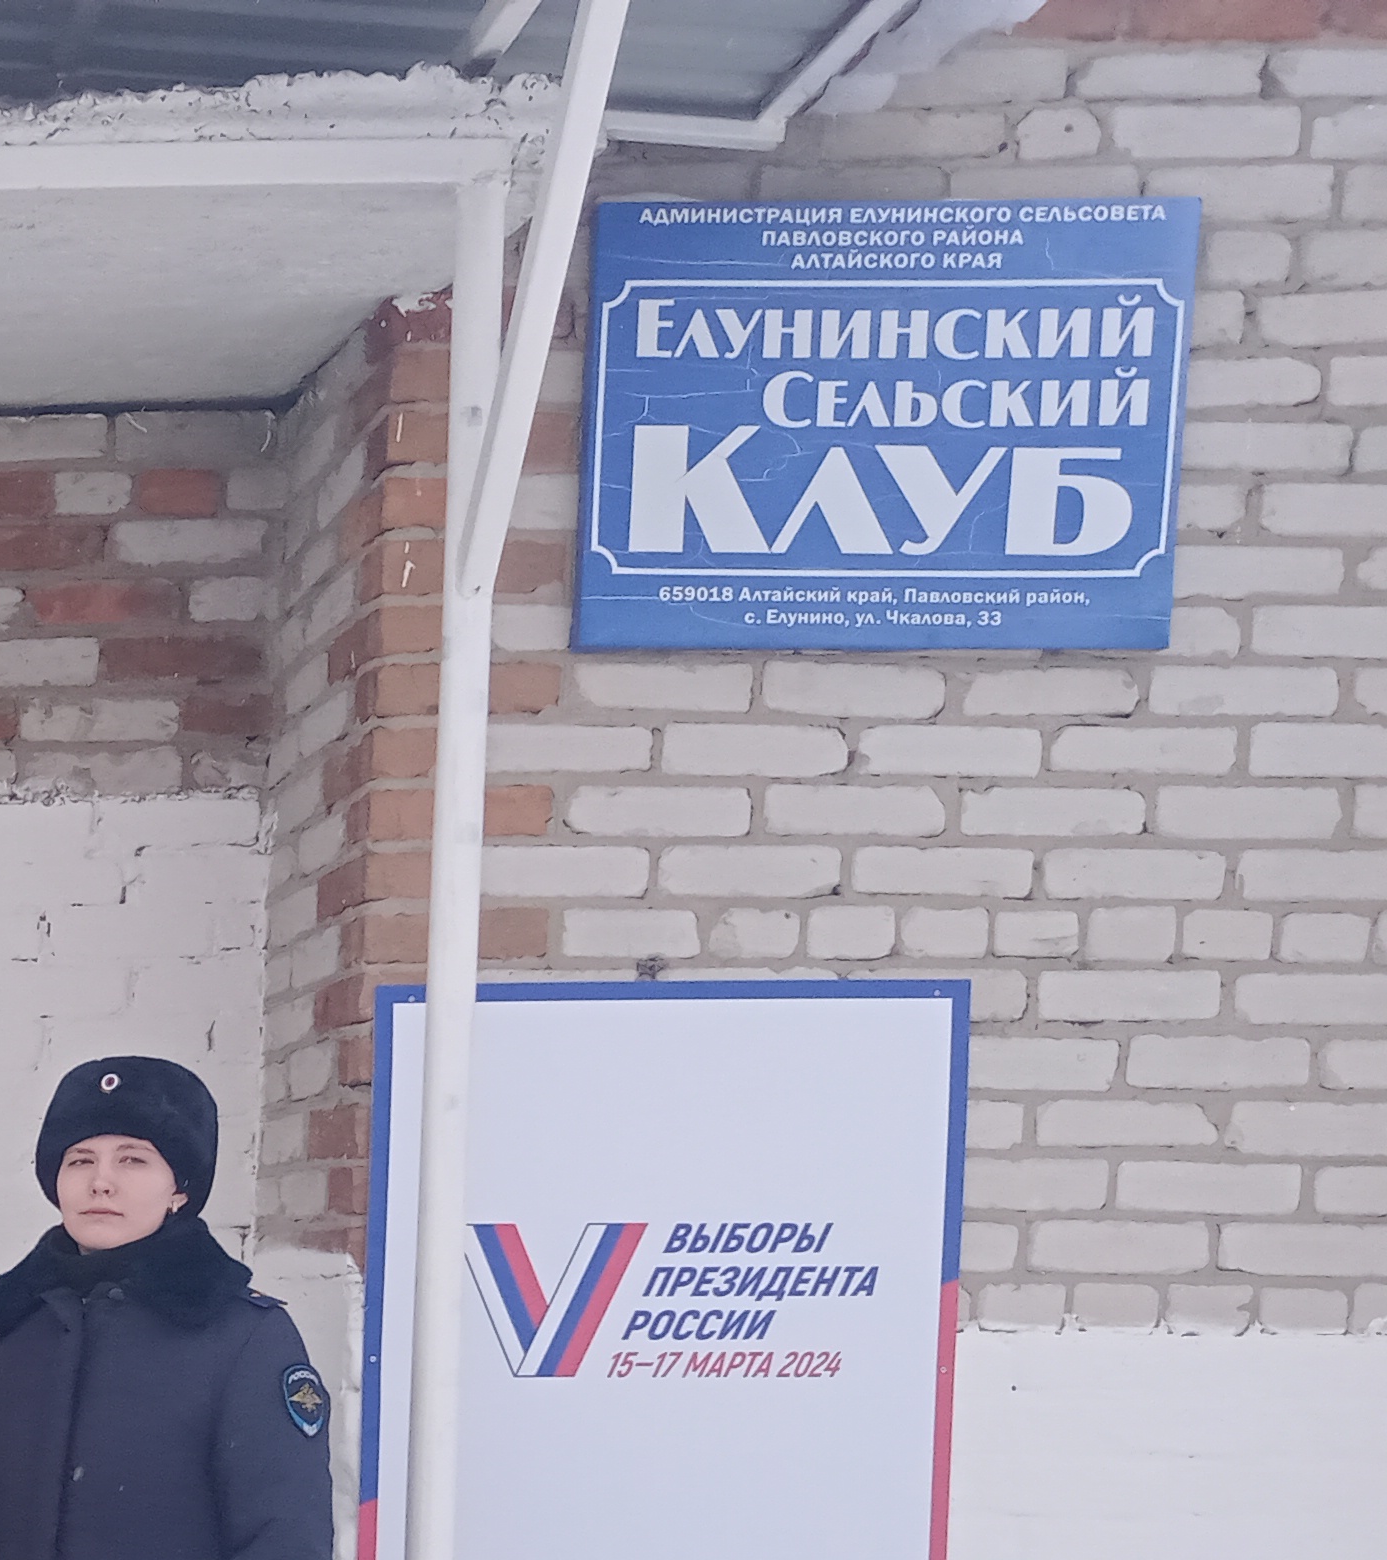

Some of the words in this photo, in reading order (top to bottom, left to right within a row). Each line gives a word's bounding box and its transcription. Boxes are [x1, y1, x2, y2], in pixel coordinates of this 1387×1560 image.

[639, 205, 842, 226] АДМИНИСТРАЦИЯ
[849, 205, 1011, 224] ЕЛУНИНСКОГО
[1019, 203, 1166, 222] СЕЛЬСОВЕТА
[761, 229, 926, 247] ПАВЛОВСКОГО
[932, 225, 1024, 247] РАЙОНА
[790, 248, 936, 270] АЛТАЙСКОГО
[943, 251, 1002, 270] КРАЯ
[628, 424, 1133, 555] КЛУБ
[658, 586, 733, 602] 659018
[738, 584, 840, 604] Алтайский
[846, 586, 898, 606] край,
[903, 586, 1020, 605] Павловский
[1026, 587, 1091, 608] район,
[744, 612, 762, 625] с.
[766, 610, 849, 629] Елунино,
[855, 612, 881, 628] ул.
[886, 610, 971, 629] Чкалова,
[977, 611, 1002, 626] 33
[662, 1222, 834, 1254] ВЫБОРЫ
[641, 1265, 879, 1302] ПРЕЗИДЕНТА
[621, 1309, 776, 1341] РОССИИ
[681, 1351, 774, 1379] МАРТА
[777, 1350, 843, 1379] 2024
